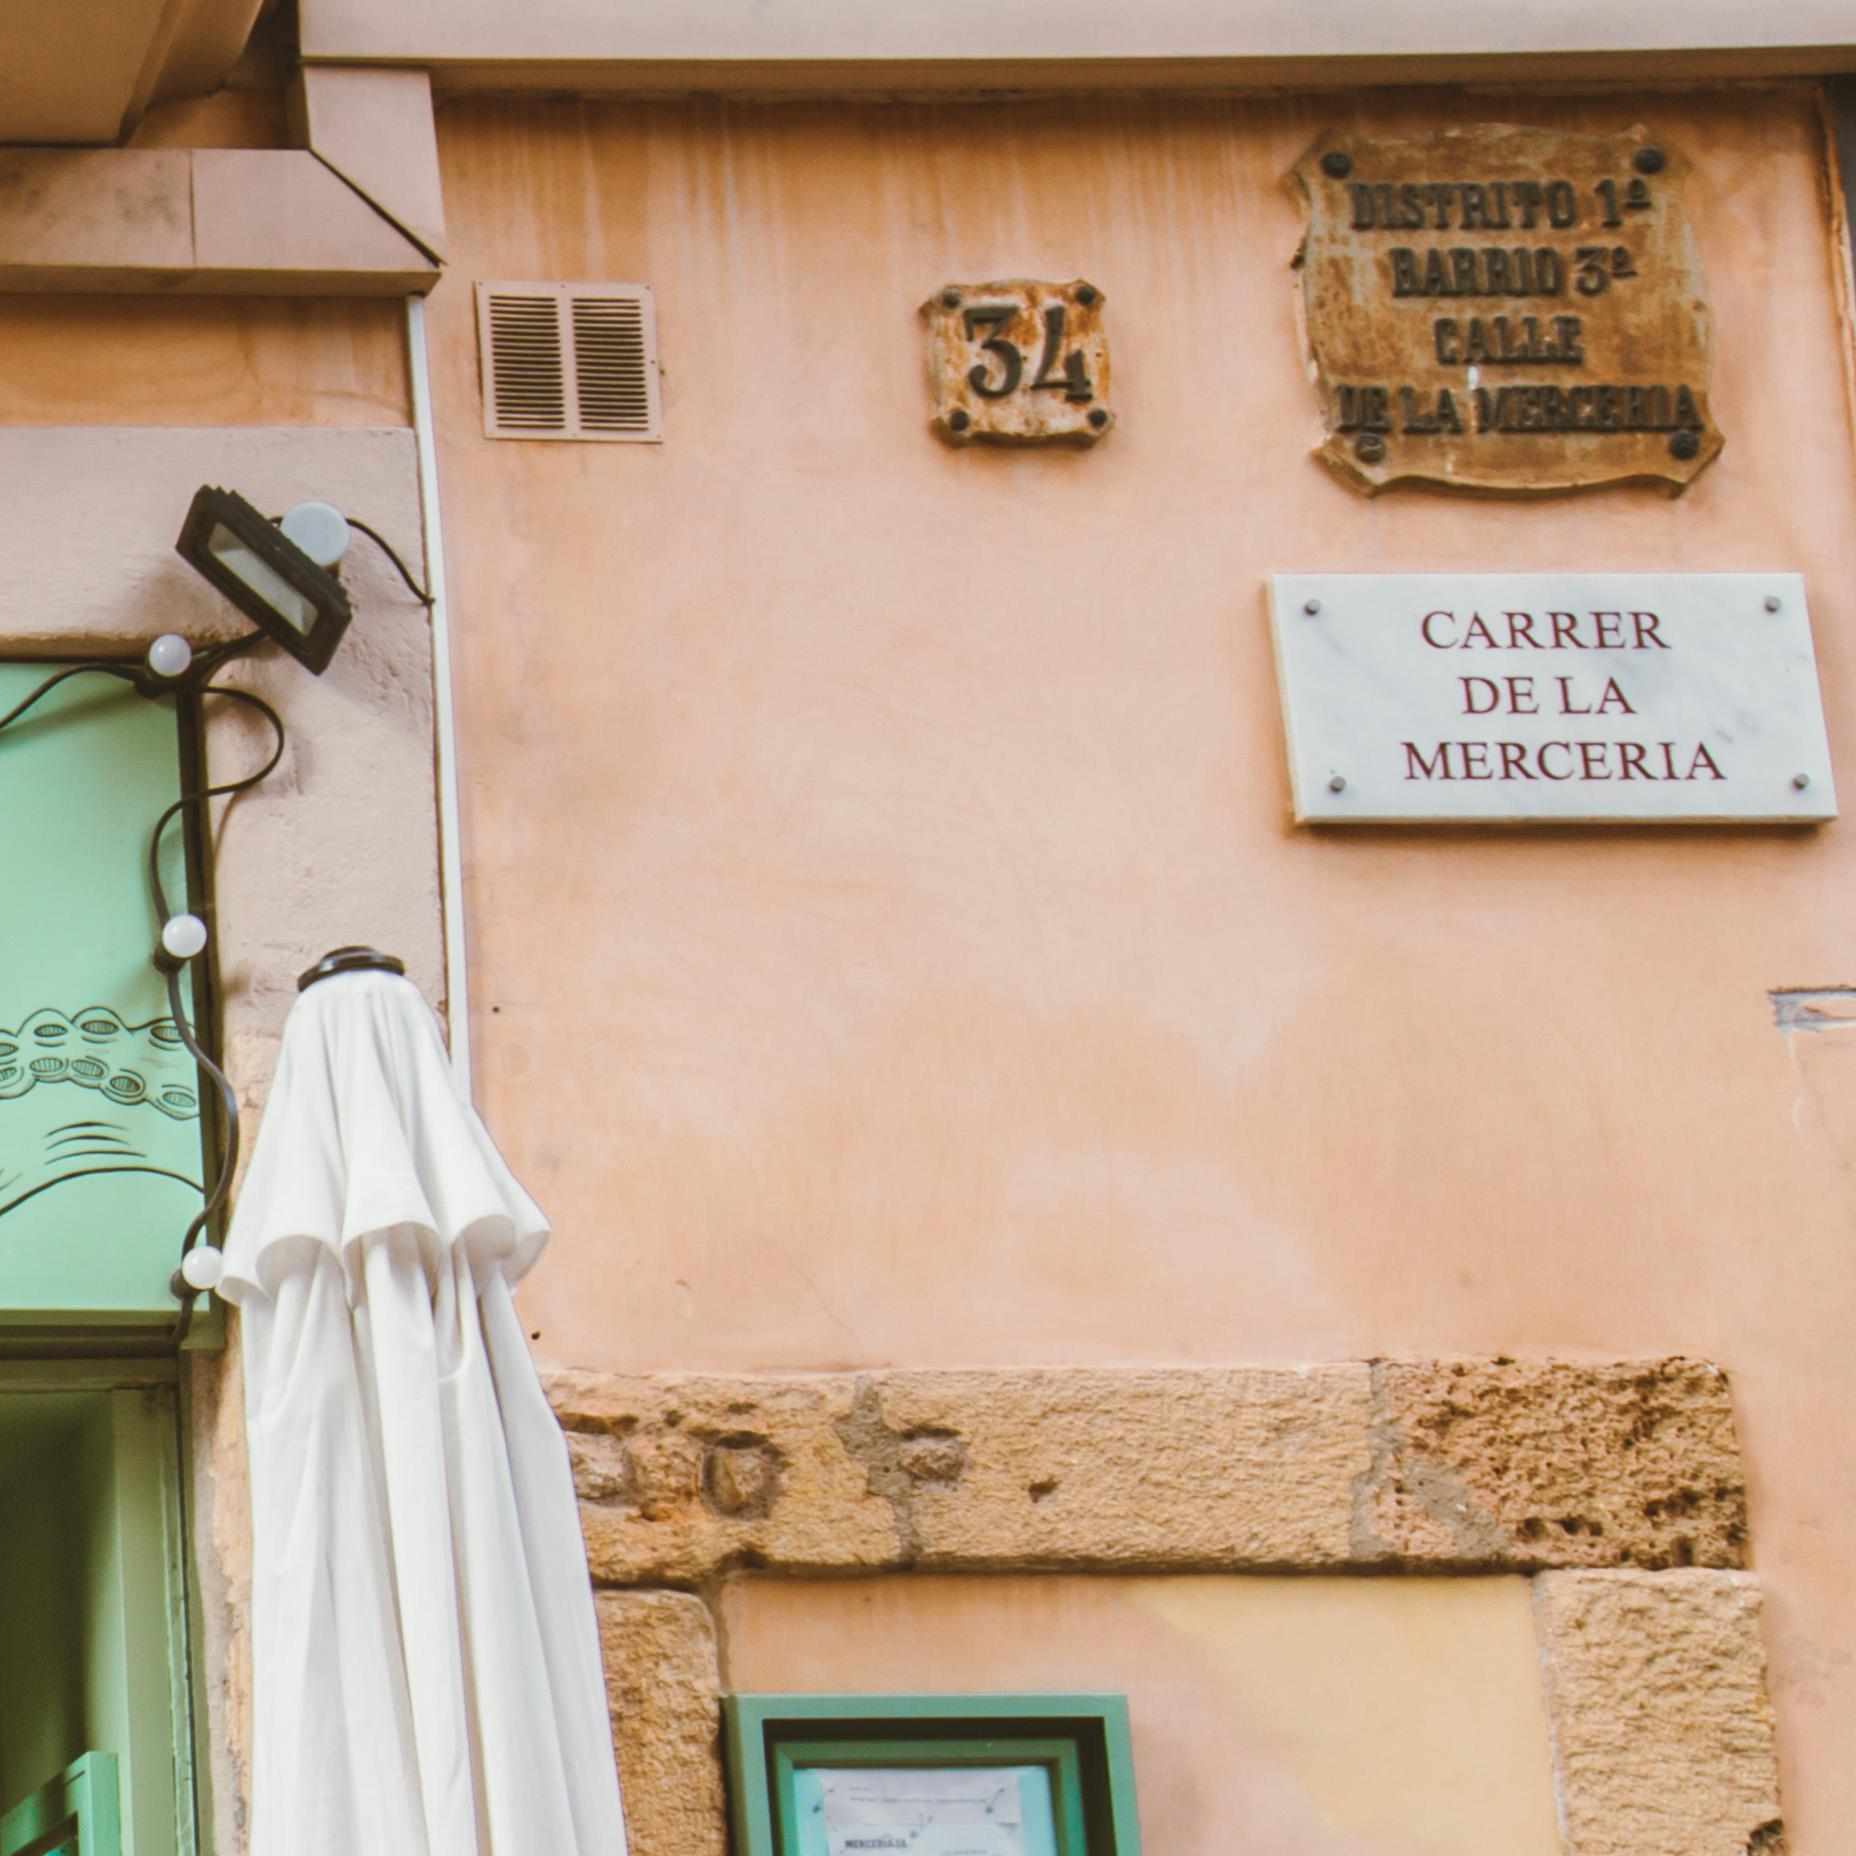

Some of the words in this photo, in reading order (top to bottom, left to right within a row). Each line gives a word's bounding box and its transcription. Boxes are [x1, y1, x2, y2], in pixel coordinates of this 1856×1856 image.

[1347, 181, 1576, 231] DISTRITO
[1391, 247, 1564, 298] BARRIO
[964, 305, 1092, 402] 34
[1434, 315, 1584, 365] CALLE
[1335, 384, 1392, 433] DE
[1399, 385, 1462, 434] LA
[1475, 384, 1705, 434] MERCERIA
[1421, 610, 1671, 651] CARRER
[1458, 676, 1540, 716] DE
[1556, 676, 1637, 716] LA
[1402, 741, 1728, 782] MERCERIA
